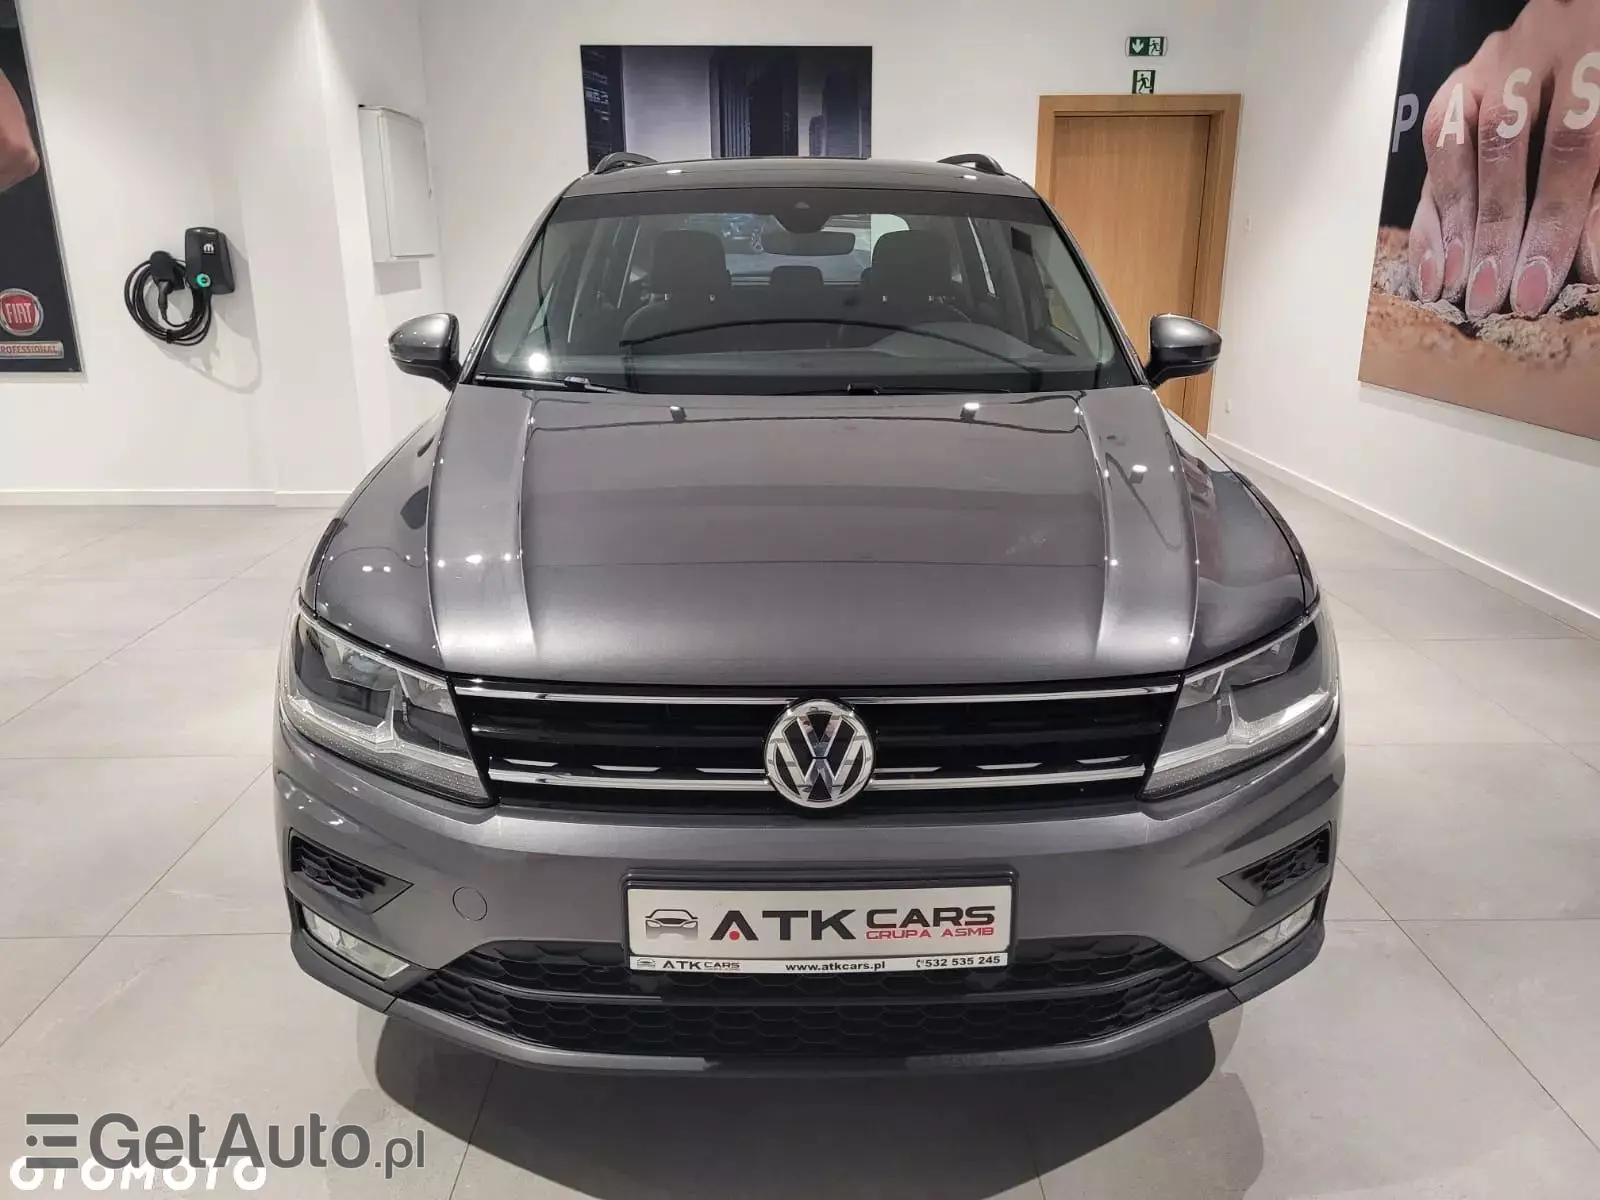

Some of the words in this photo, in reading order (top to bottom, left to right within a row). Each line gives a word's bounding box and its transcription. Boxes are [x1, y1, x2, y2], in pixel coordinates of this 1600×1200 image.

[5, 303, 33, 324] FIAT
[710, 909, 857, 941] ATK
[866, 905, 996, 929] CARS
[866, 929, 932, 940] GRUPA
[941, 926, 995, 938] ASMB
[662, 960, 702, 970] ATK
[703, 961, 741, 969] CARS
[785, 961, 886, 972] www.atkcars.pl
[925, 958, 948, 968] 532
[951, 957, 975, 967] 535
[978, 955, 1001, 965] 245
